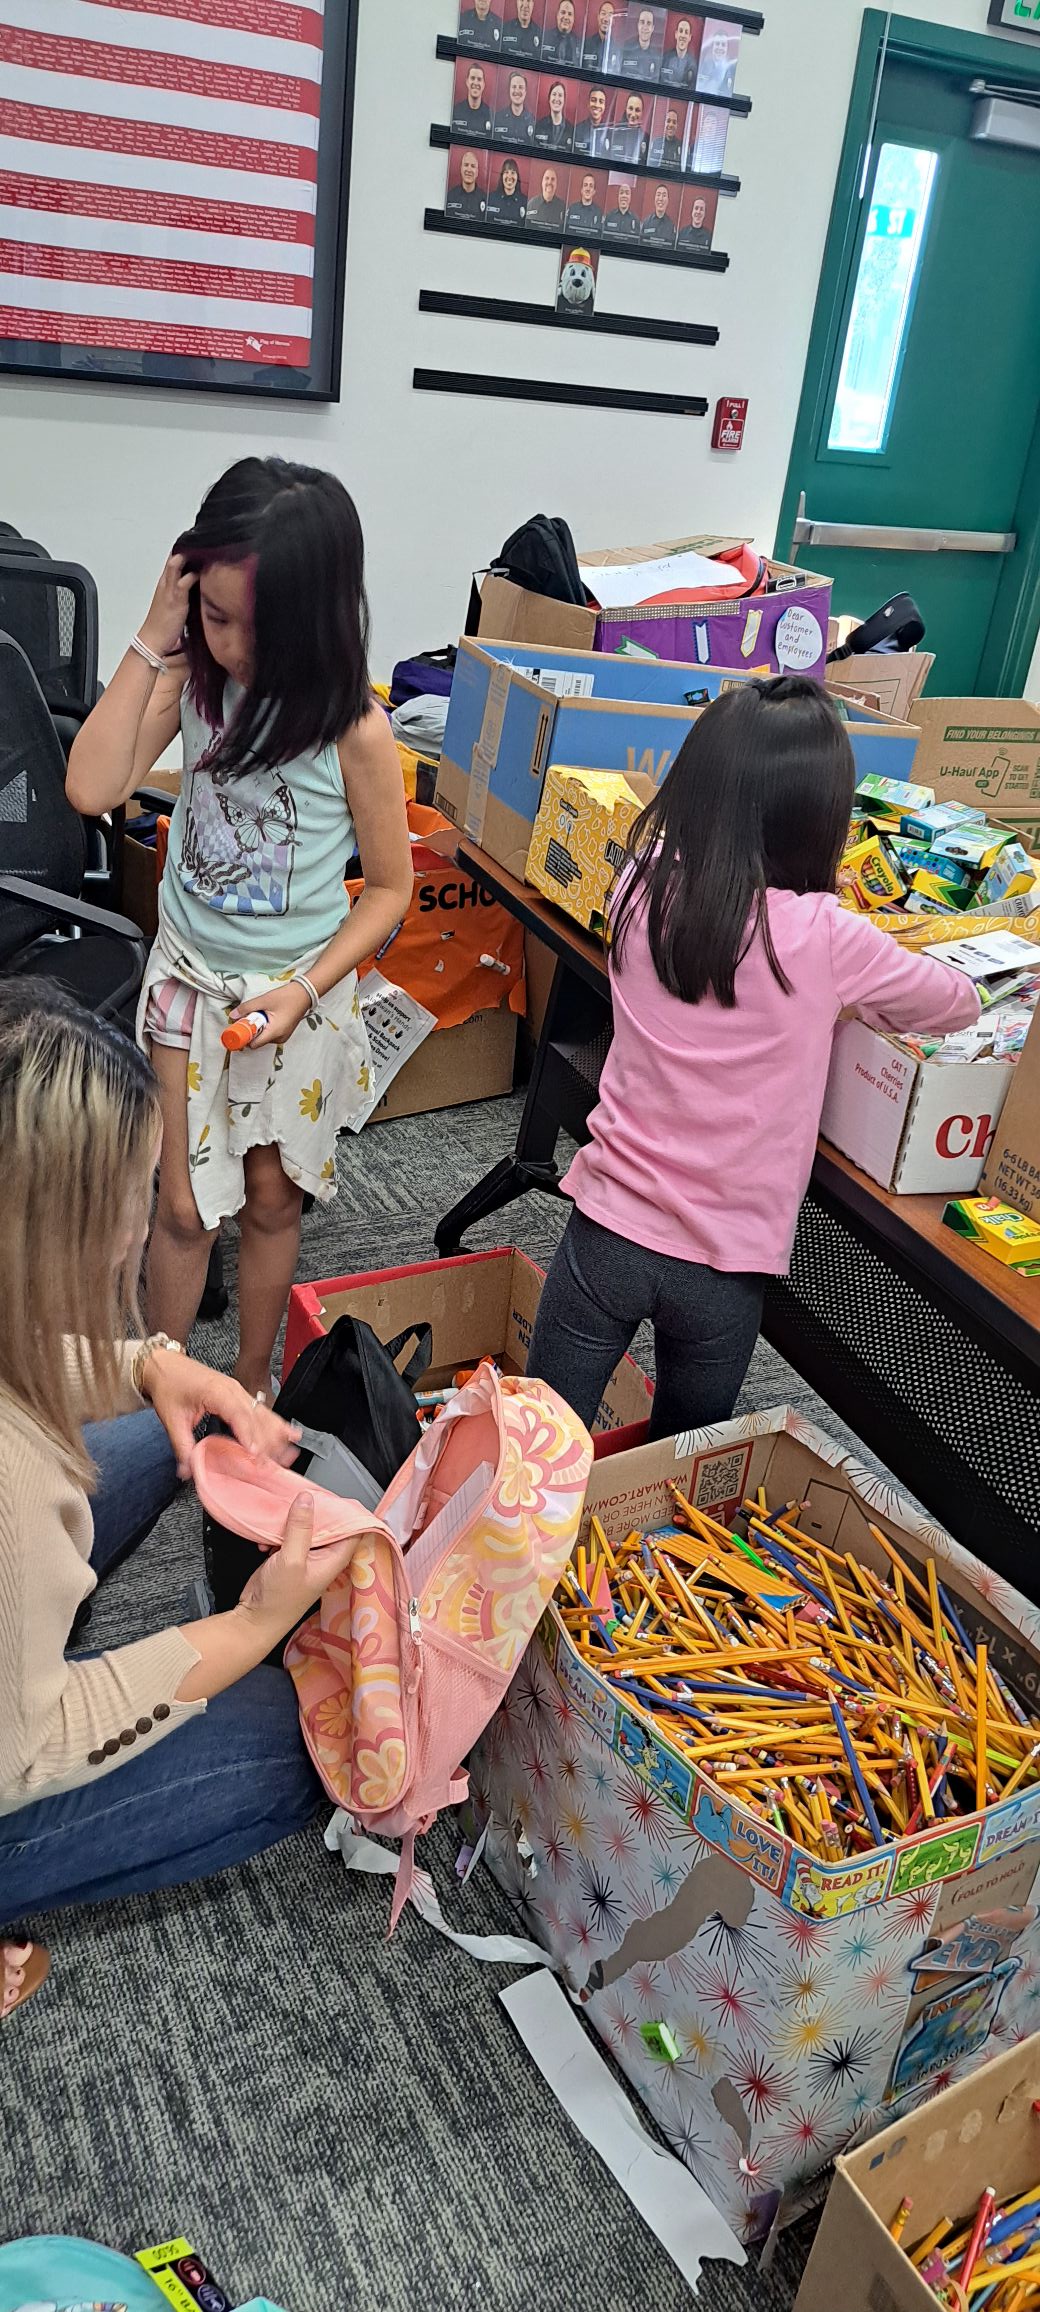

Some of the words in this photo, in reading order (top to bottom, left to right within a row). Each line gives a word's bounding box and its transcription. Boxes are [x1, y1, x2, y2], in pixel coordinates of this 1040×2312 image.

[721, 430, 741, 440] FIRE
[787, 608, 804, 620] Dear
[784, 634, 800, 643] and
[777, 641, 813, 659] employees
[945, 729, 965, 739] FIND
[966, 730, 987, 740] YOUR
[978, 767, 1000, 779] App
[1009, 773, 1018, 781] TO
[870, 856, 895, 893] Crayola
[394, 1005, 412, 1022] support
[364, 1020, 382, 1036] Annual
[379, 1030, 401, 1051] Backpack
[373, 1035, 389, 1051] School
[375, 1047, 390, 1062] Drive!
[891, 1059, 903, 1073] CAT
[854, 1062, 876, 1087] Product
[883, 1083, 899, 1104] U.S.A.
[880, 1067, 904, 1090] Cherries
[1003, 1148, 1017, 1165] 6-6
[1017, 1157, 1028, 1172] LB
[998, 1162, 1016, 1181] NET
[1015, 1173, 1031, 1192] WT
[994, 1176, 1019, 1201] (16.33
[1018, 1195, 1034, 1213] kg)
[979, 1211, 1025, 1226] Chalk
[602, 1510, 620, 1525] OR
[623, 1498, 652, 1518] HERE
[652, 1505, 680, 1520] EED
[616, 1513, 651, 1534] MORE
[559, 1658, 587, 1704] DREAM
[591, 1701, 607, 1723] IT!
[736, 1820, 782, 1864] LOVE
[985, 1817, 1028, 1847] DREAM
[751, 1855, 777, 1881] IT!
[820, 1871, 864, 1891] READ
[865, 1859, 889, 1881] IT!
[985, 1876, 999, 1890] TO
[999, 1861, 1025, 1884] HOLD
